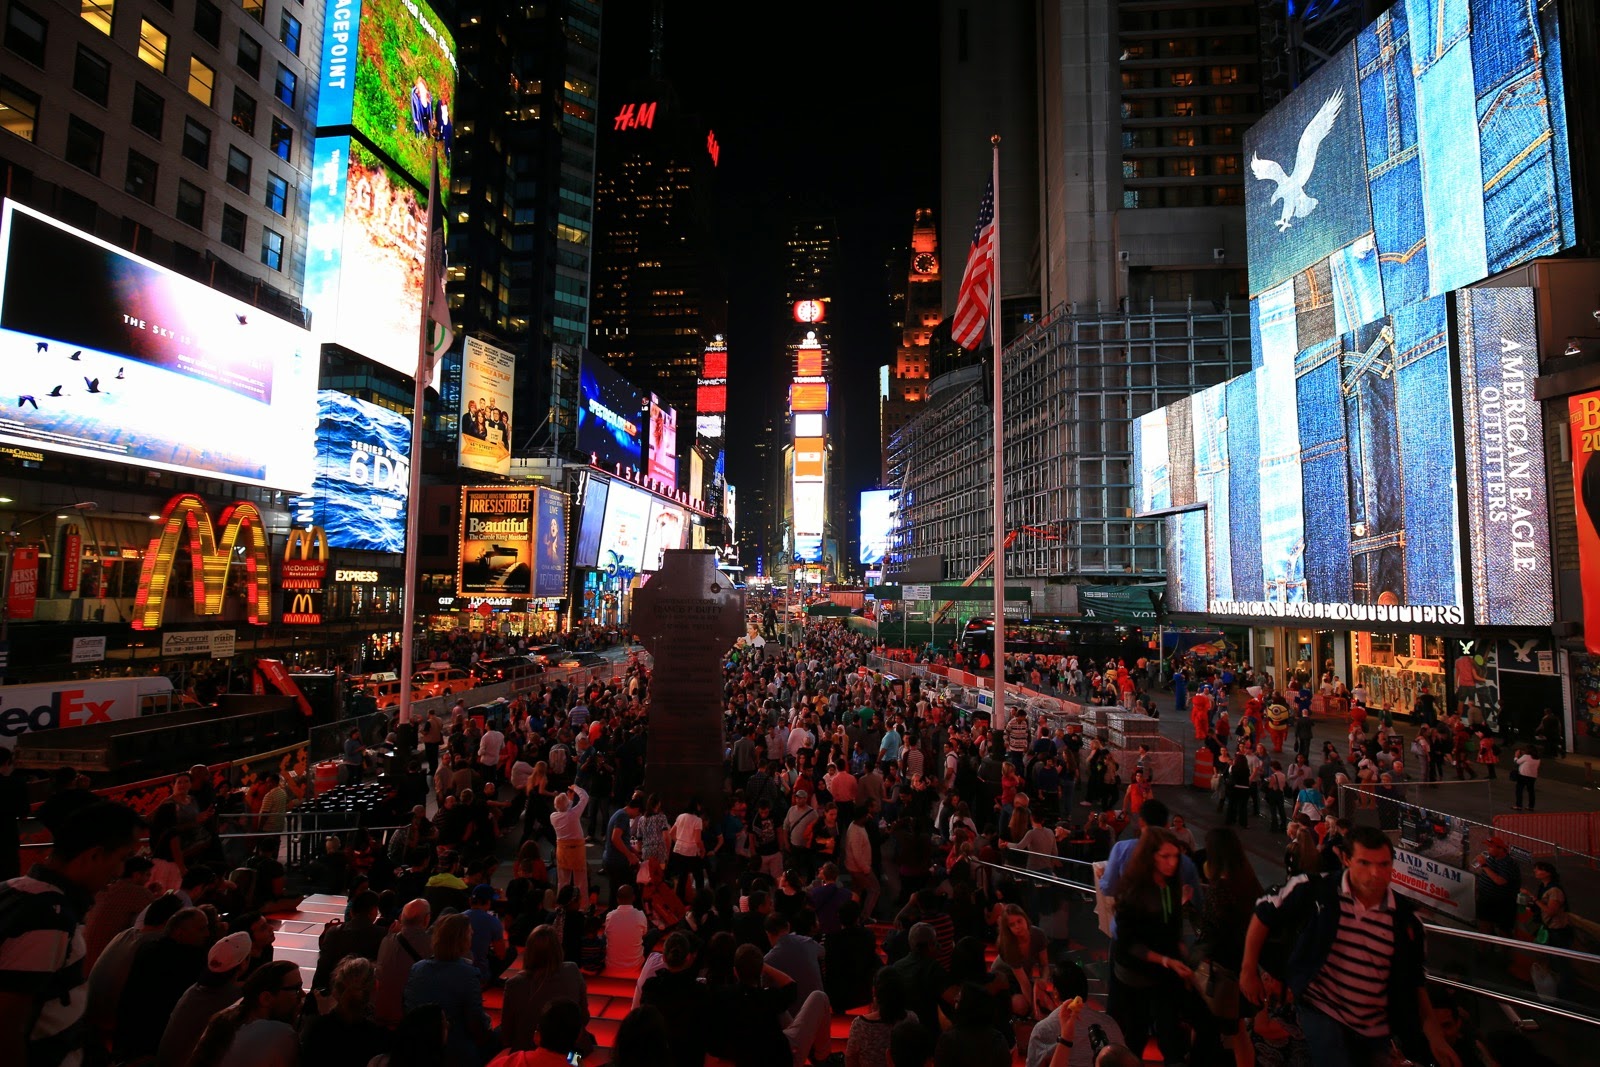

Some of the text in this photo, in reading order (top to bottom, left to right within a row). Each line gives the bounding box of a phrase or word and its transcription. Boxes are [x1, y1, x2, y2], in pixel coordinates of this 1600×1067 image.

[614, 102, 657, 131] H&M
[123, 314, 191, 345] THE SKY IS
[351, 440, 383, 456] SERIES
[1481, 386, 1508, 522] OUTFITTERS
[1500, 337, 1536, 572] AMERICAN EAGLE
[349, 450, 369, 486] 6
[615, 462, 649, 488] 1540
[651, 480, 706, 512] BROADWAY
[469, 517, 529, 533] Beautiful
[496, 533, 508, 541] King
[508, 533, 529, 541] Musical
[10, 568, 39, 583] JERSEY
[283, 564, 325, 572] McDonald's
[335, 570, 379, 582] EXPRESS
[14, 581, 36, 595] BOYS
[1209, 600, 1463, 625] AMERICAN EAGLE OUTFITTERS
[174, 635, 209, 643] Summit
[0, 689, 116, 737] edEx
[1426, 861, 1462, 883] SLAM
[1429, 883, 1450, 899] Sale
